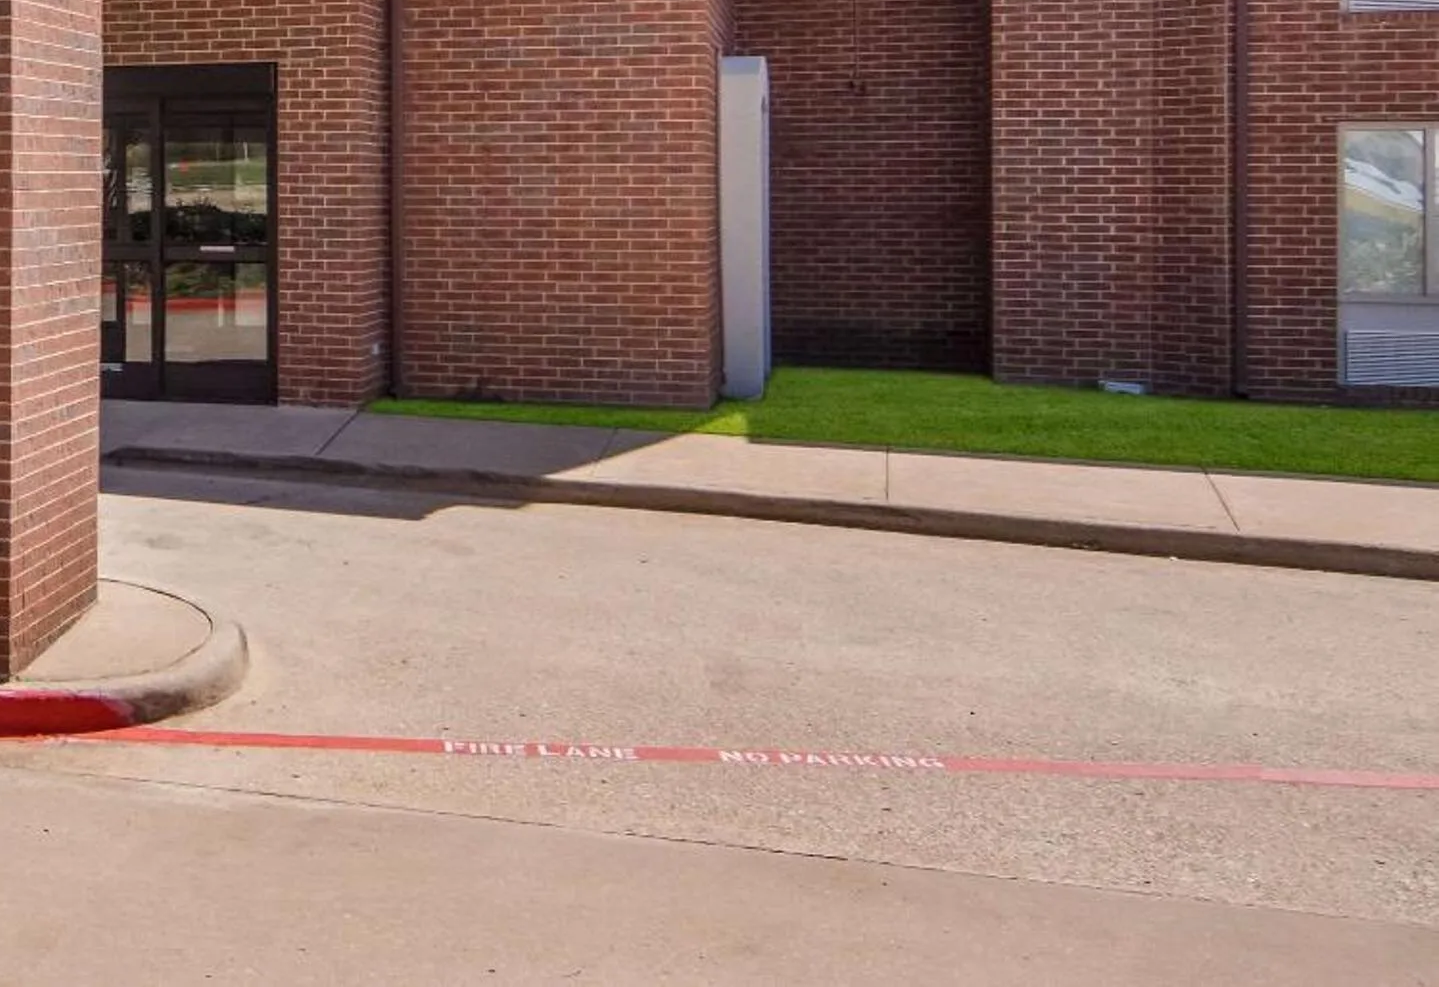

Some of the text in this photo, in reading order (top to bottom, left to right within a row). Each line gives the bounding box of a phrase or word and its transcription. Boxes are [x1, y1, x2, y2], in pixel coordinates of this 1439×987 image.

[444, 739, 945, 769] FIRE LANE NO PARKING
